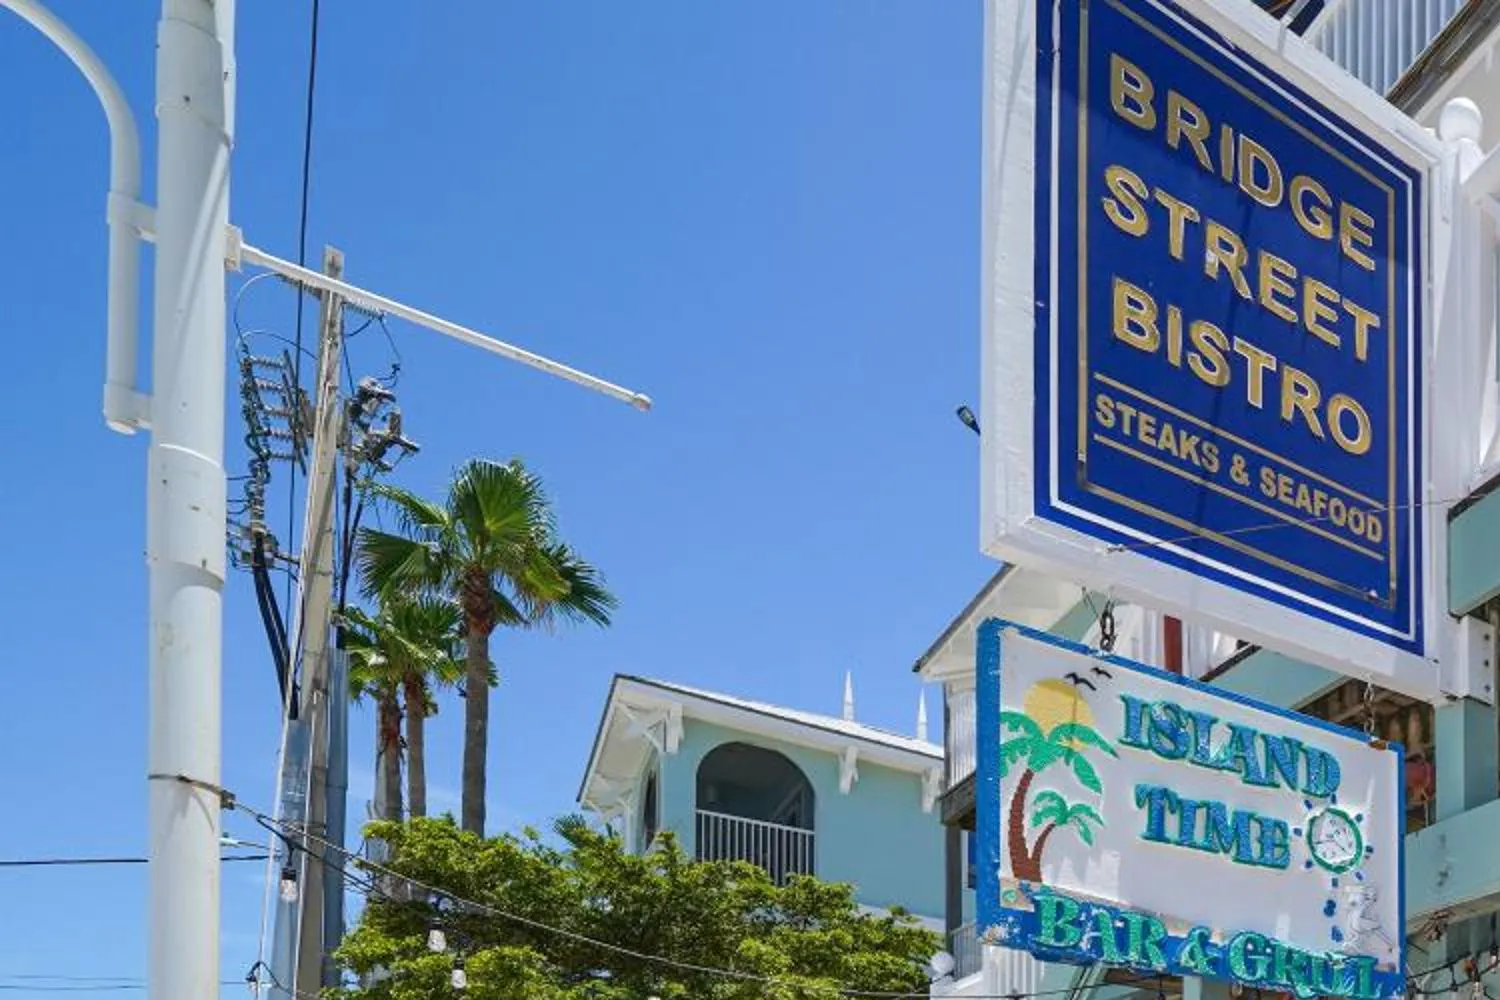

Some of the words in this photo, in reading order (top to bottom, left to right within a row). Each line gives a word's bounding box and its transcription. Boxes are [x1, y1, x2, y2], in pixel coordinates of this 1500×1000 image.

[1109, 52, 1377, 272] BRIDGE
[1102, 164, 1381, 361] STREET
[1111, 277, 1373, 455] BISTRO
[1095, 393, 1219, 473] STEAKS
[1229, 454, 1250, 486] &
[1259, 466, 1383, 543] SEAFOOD
[1118, 693, 1341, 799] ISLAND
[1135, 783, 1291, 870] TIME
[1033, 892, 1168, 968] BAR
[1179, 925, 1217, 976] &
[1228, 931, 1381, 1000] GRILL
